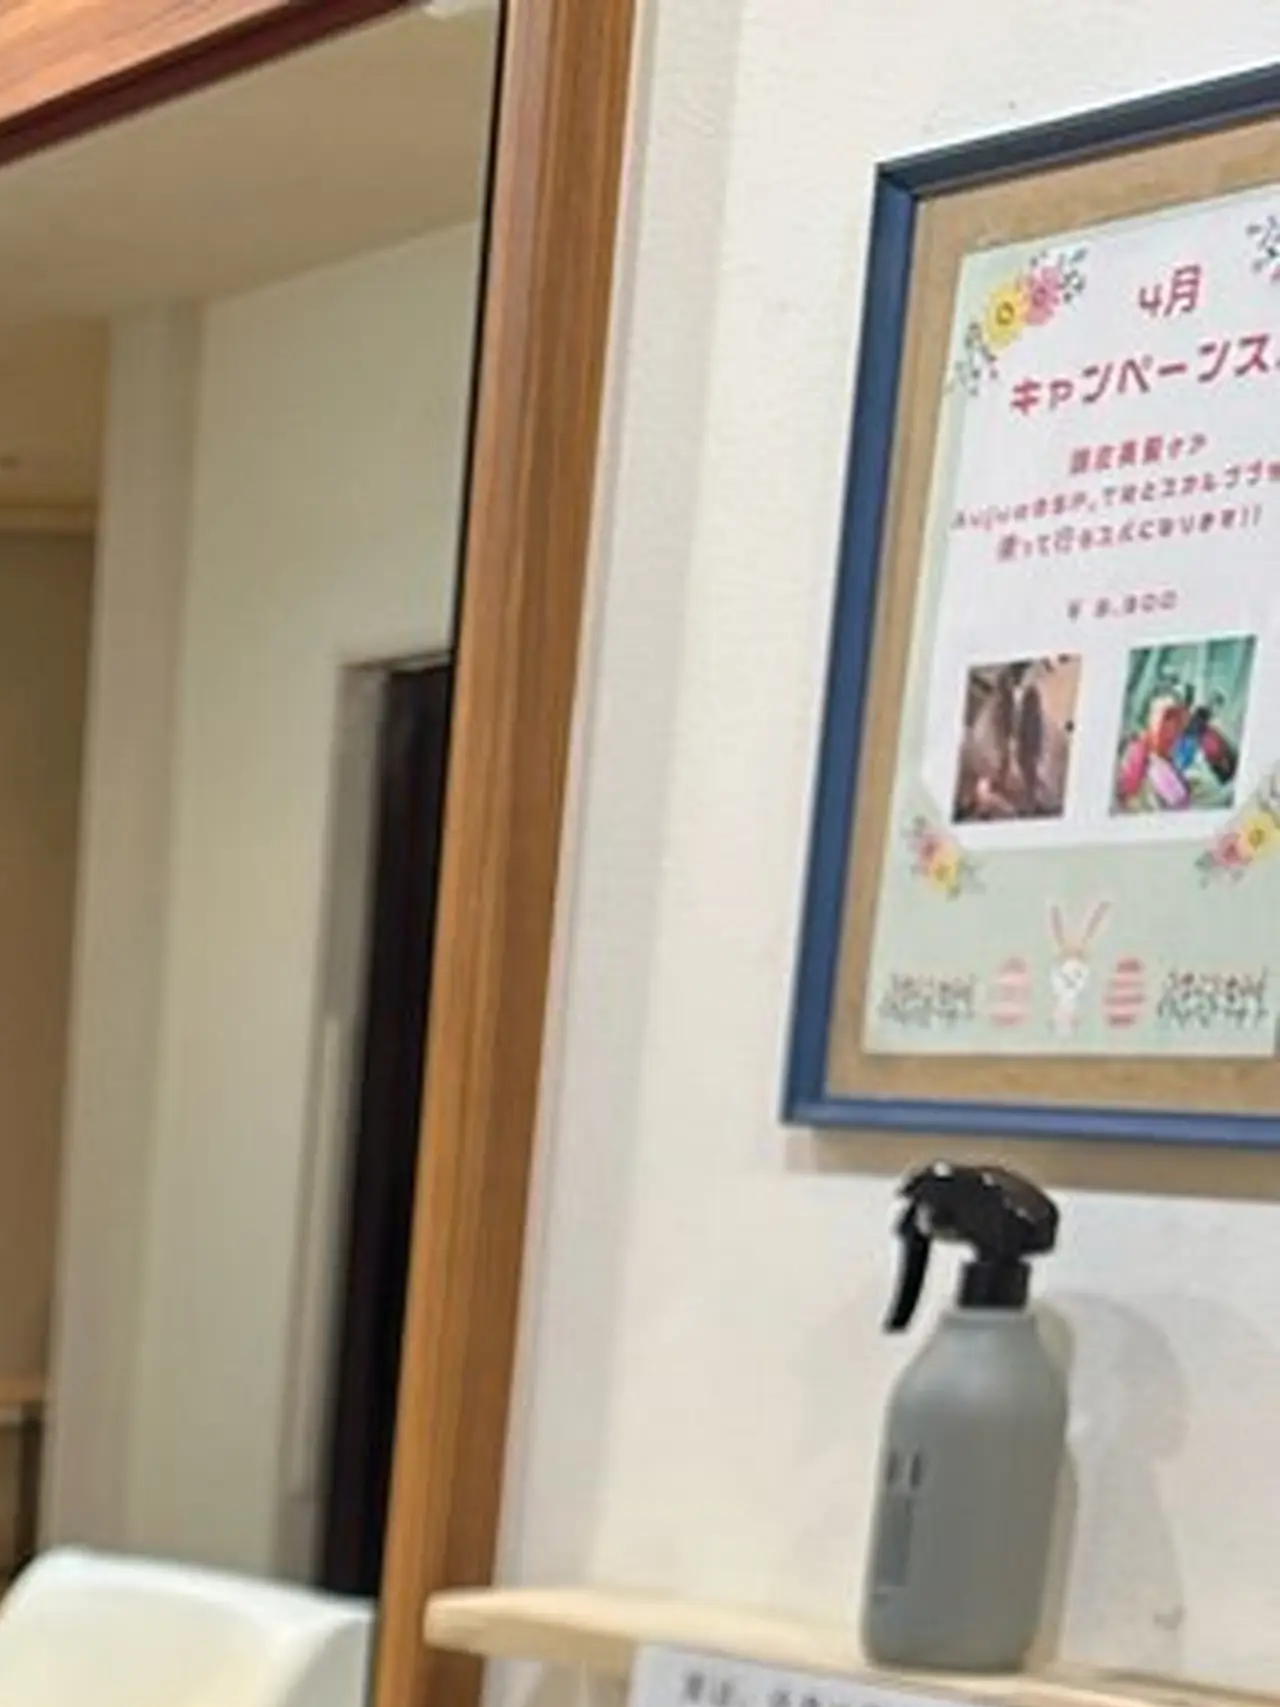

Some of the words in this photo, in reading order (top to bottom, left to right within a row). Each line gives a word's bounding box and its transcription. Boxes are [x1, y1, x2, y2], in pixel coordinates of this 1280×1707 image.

[1139, 264, 1202, 317] 4月
[1010, 333, 1280, 414] キャンペーンス
